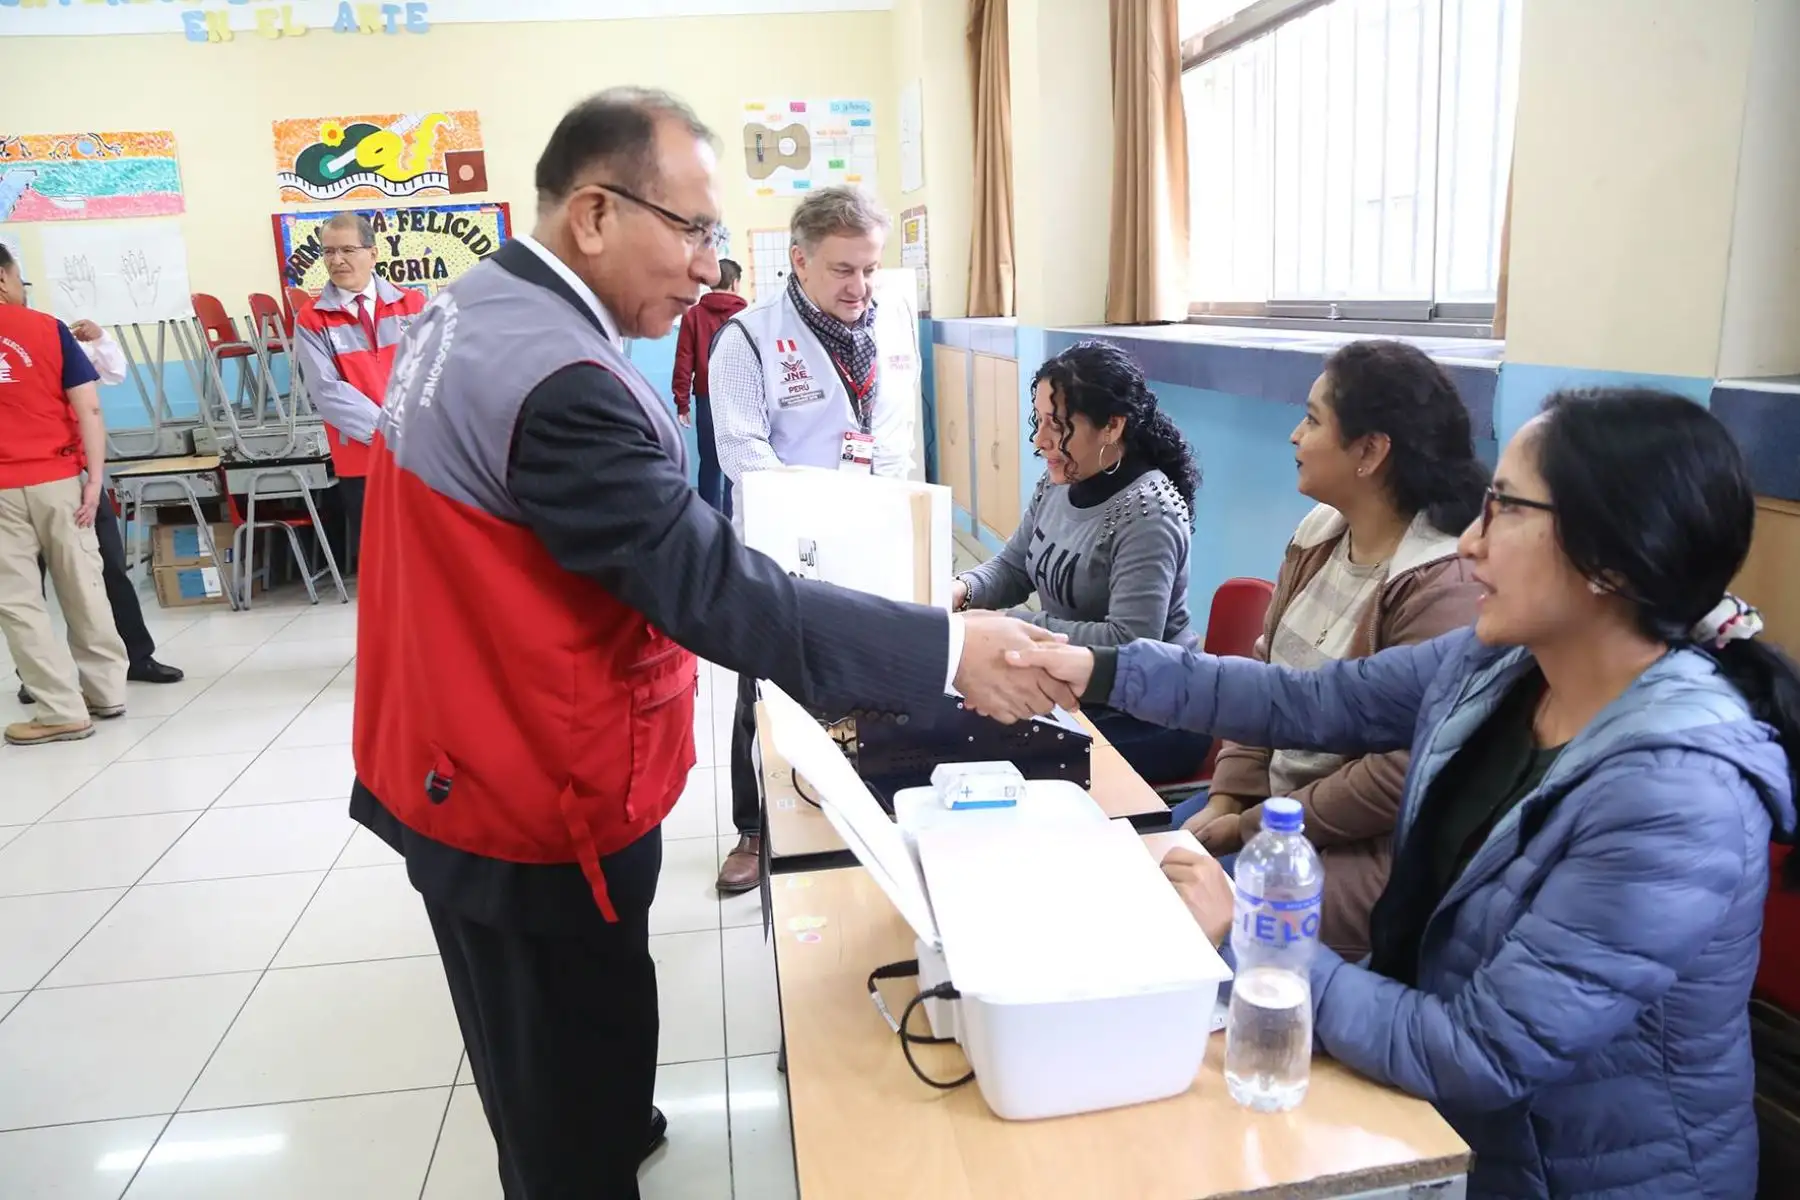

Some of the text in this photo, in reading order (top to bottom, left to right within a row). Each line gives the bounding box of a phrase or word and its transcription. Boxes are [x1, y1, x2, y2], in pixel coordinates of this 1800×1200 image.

[182, 1, 430, 42] EN EL ARTE
[386, 234, 401, 257] Y
[396, 209, 492, 261] FELICID
[375, 246, 449, 283] EGRÍA
[784, 371, 808, 381] JNE
[788, 381, 810, 393] PERÚ
